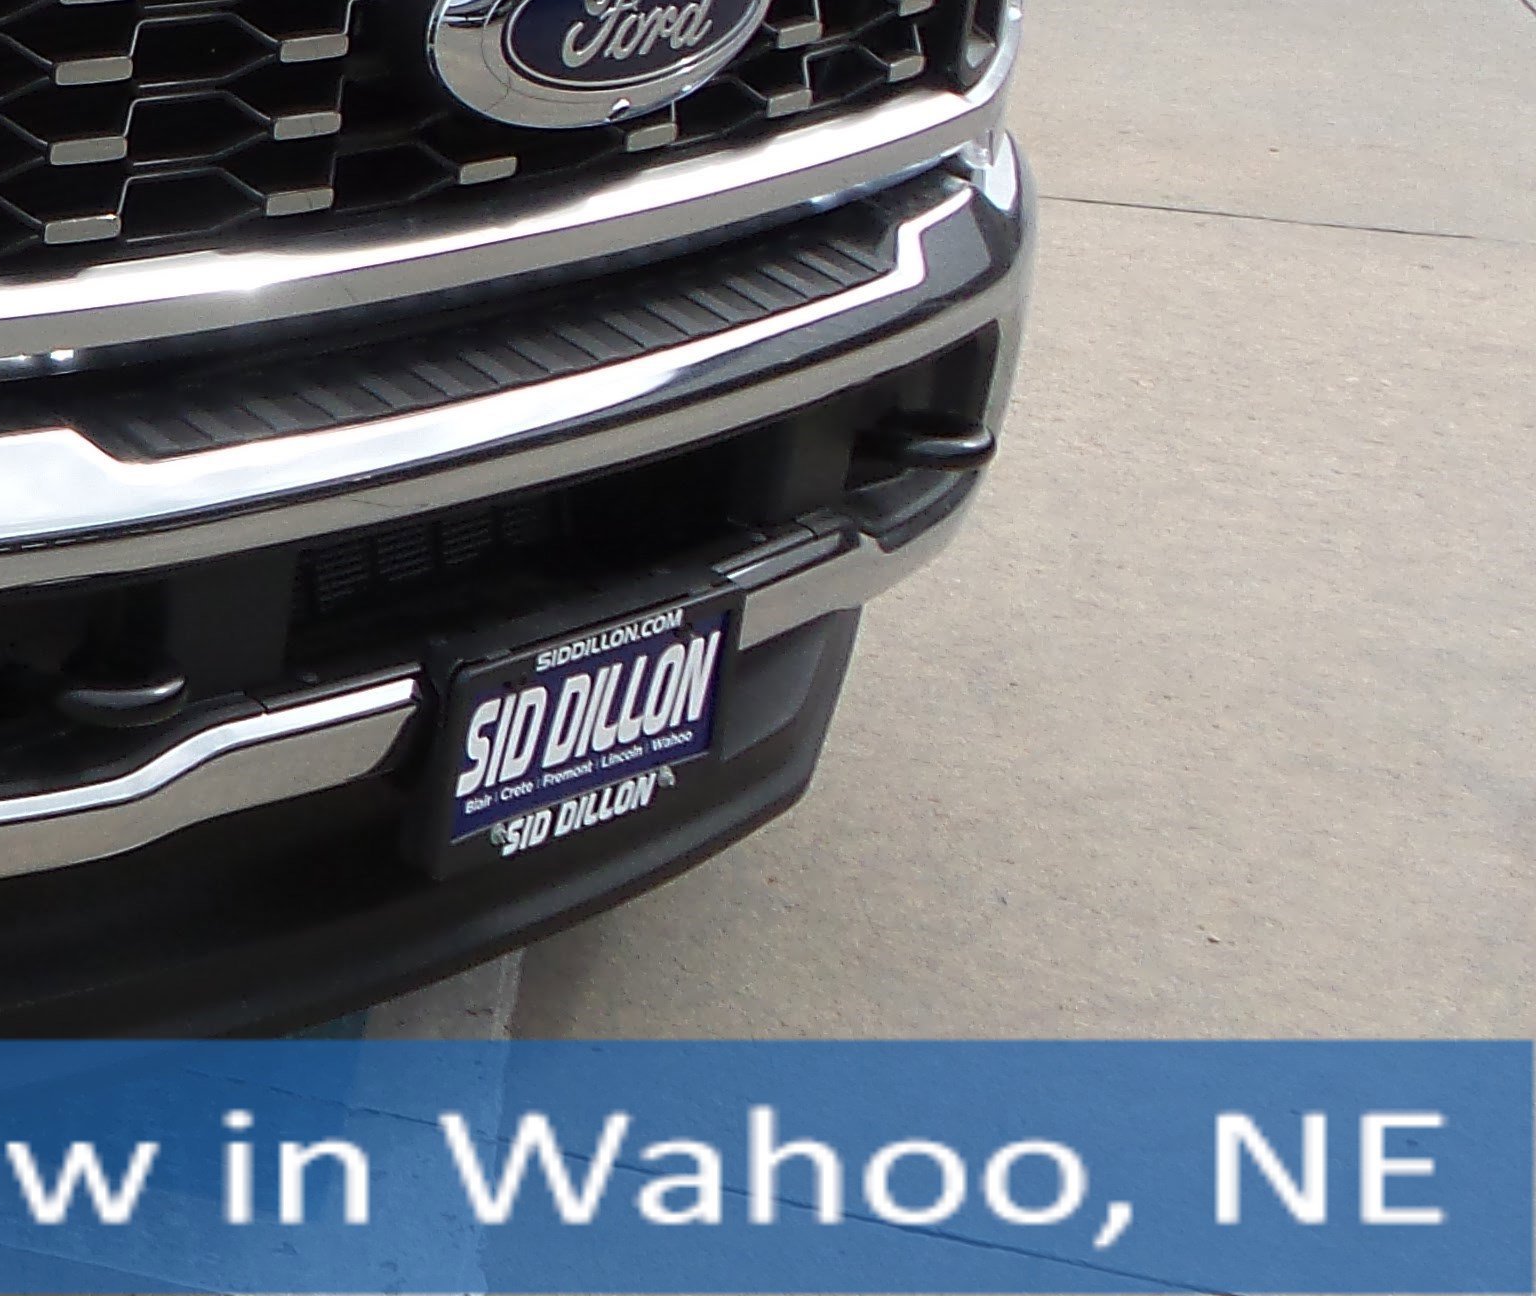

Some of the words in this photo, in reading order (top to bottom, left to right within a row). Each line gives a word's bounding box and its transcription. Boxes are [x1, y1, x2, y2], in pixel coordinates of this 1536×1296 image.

[536, 608, 684, 673] SIDDILLON.COM
[455, 685, 548, 798] SID
[541, 630, 721, 768] DILLON
[542, 759, 595, 788] Fremont
[501, 808, 554, 857] SID
[554, 771, 658, 837] DILLON
